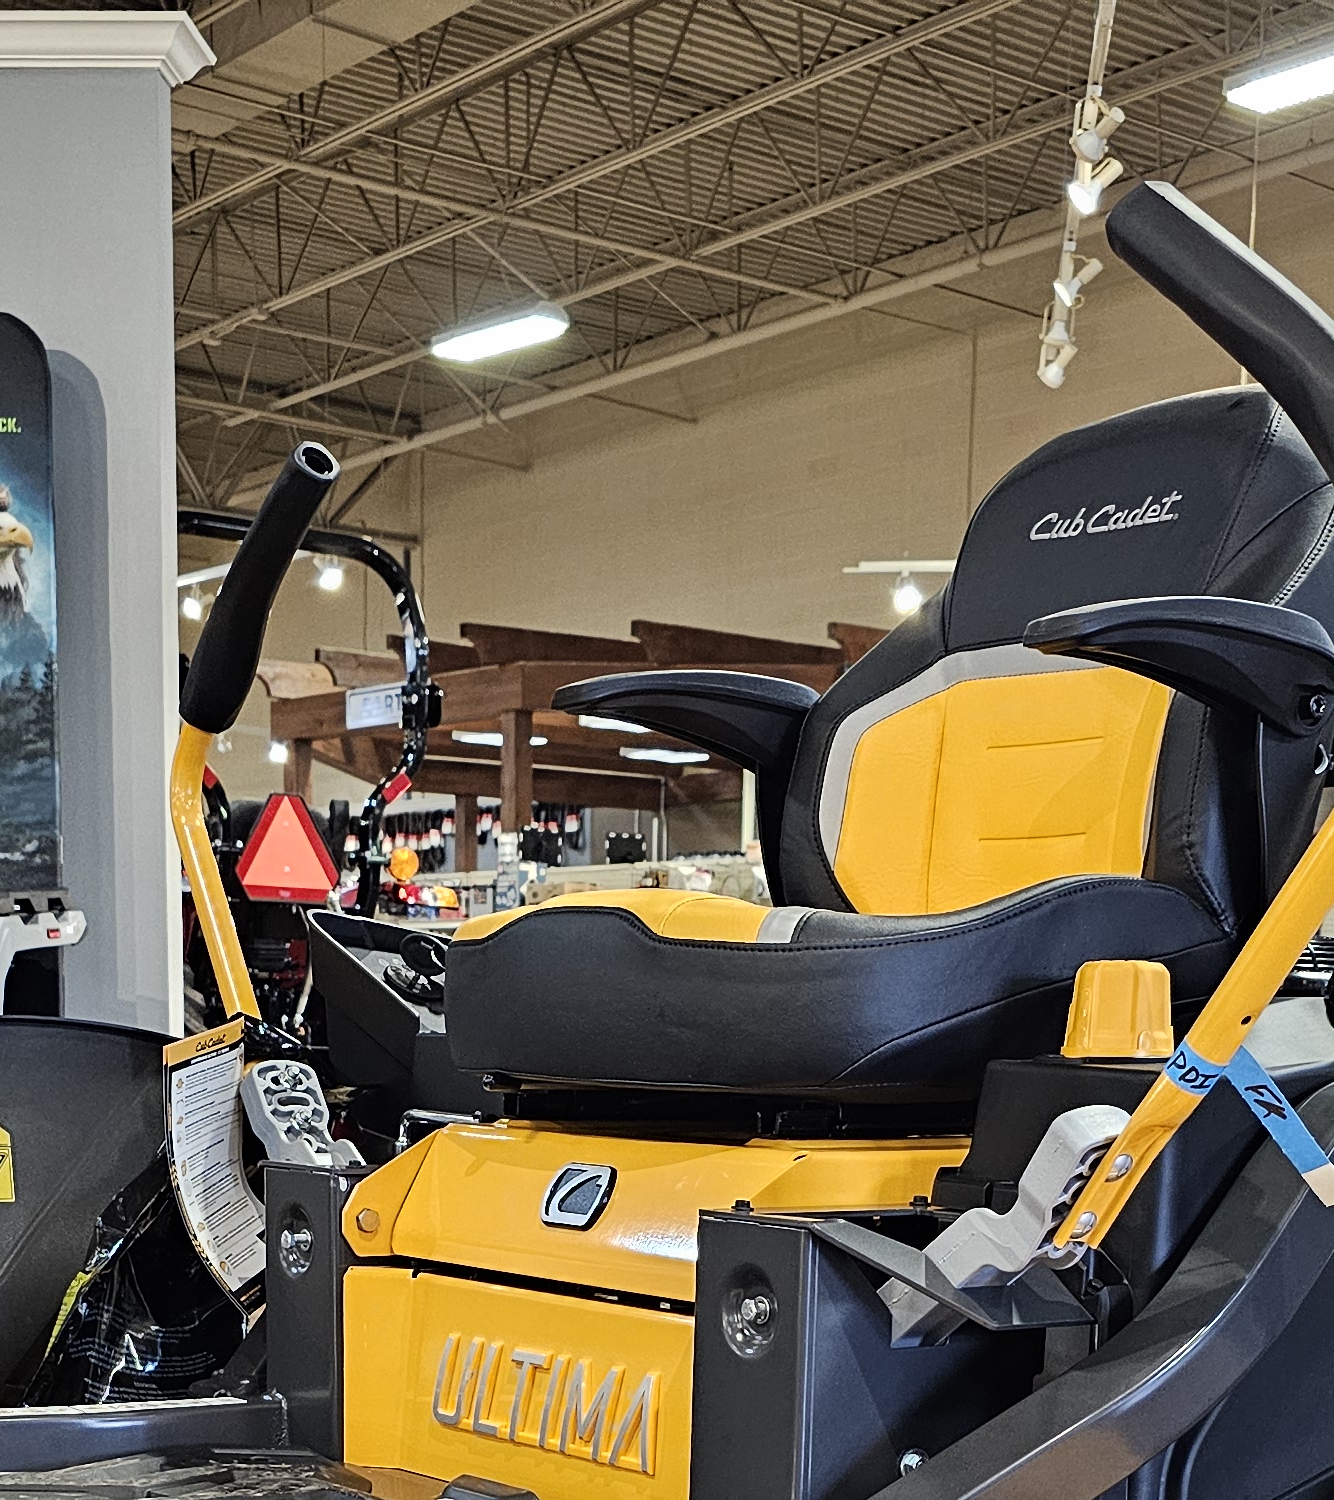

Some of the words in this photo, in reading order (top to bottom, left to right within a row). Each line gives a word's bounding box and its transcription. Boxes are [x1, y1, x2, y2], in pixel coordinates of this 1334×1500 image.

[1030, 507, 1087, 541] Cub
[1086, 490, 1183, 534] Cadet
[1167, 1050, 1219, 1089] PDI
[432, 1333, 657, 1474] ULTIMA
